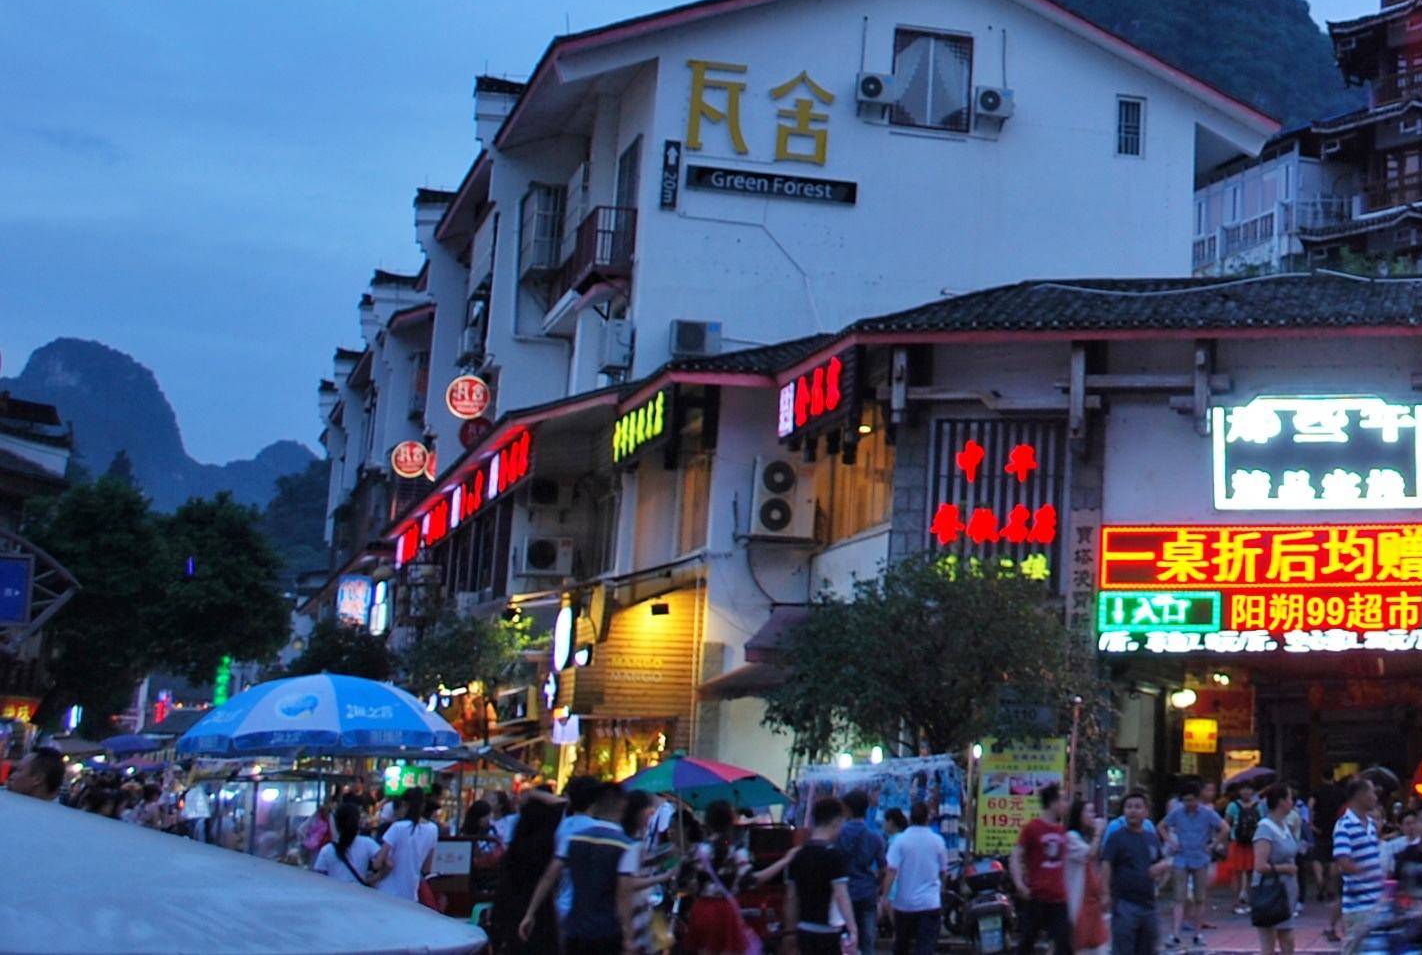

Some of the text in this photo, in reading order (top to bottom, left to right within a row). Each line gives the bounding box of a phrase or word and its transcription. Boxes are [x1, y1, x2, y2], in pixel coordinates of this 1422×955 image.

[686, 59, 835, 166] 瓦舍
[663, 171, 677, 204] 20m
[711, 171, 832, 199] Green Forest
[1230, 591, 1422, 630] 阳朔99超市
